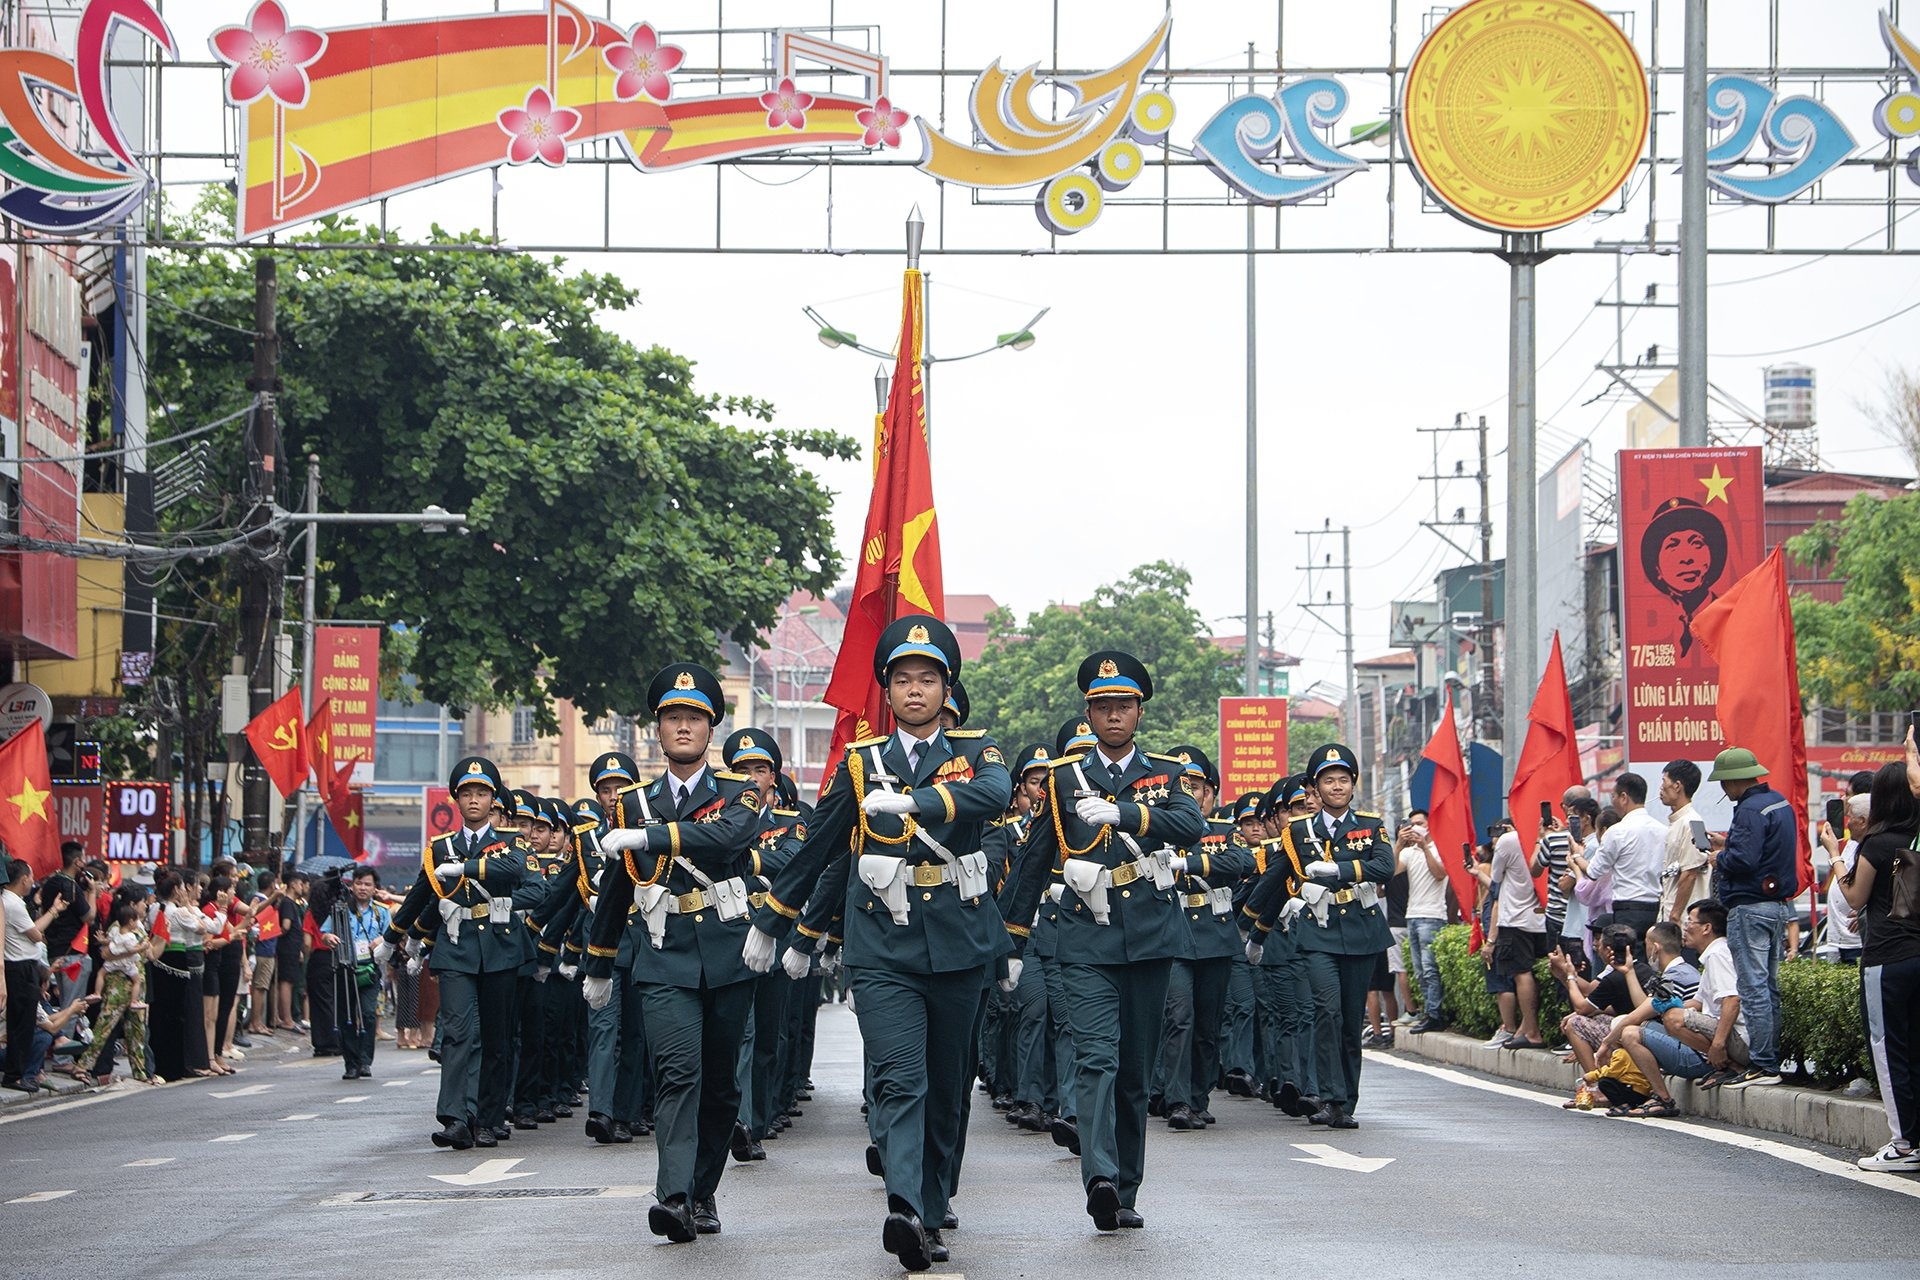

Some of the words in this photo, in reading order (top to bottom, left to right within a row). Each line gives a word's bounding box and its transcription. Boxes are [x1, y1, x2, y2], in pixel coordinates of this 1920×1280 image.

[333, 651, 359, 668] ĐẢNG
[1631, 645, 1655, 667] 7/5
[1655, 644, 1676, 656] 1954
[1654, 655, 1676, 667] 2024
[322, 674, 348, 693] CỘNG
[350, 673, 370, 691] SẢN
[1634, 681, 1666, 707] LỪNG
[1668, 677, 1691, 706] LẪY
[344, 699, 367, 714] NAM
[349, 723, 372, 738] VINH
[1638, 713, 1672, 742] CHẤN
[1674, 716, 1708, 746] ĐỘNG
[120, 788, 157, 816] ĐO
[108, 822, 165, 860] MẮT
